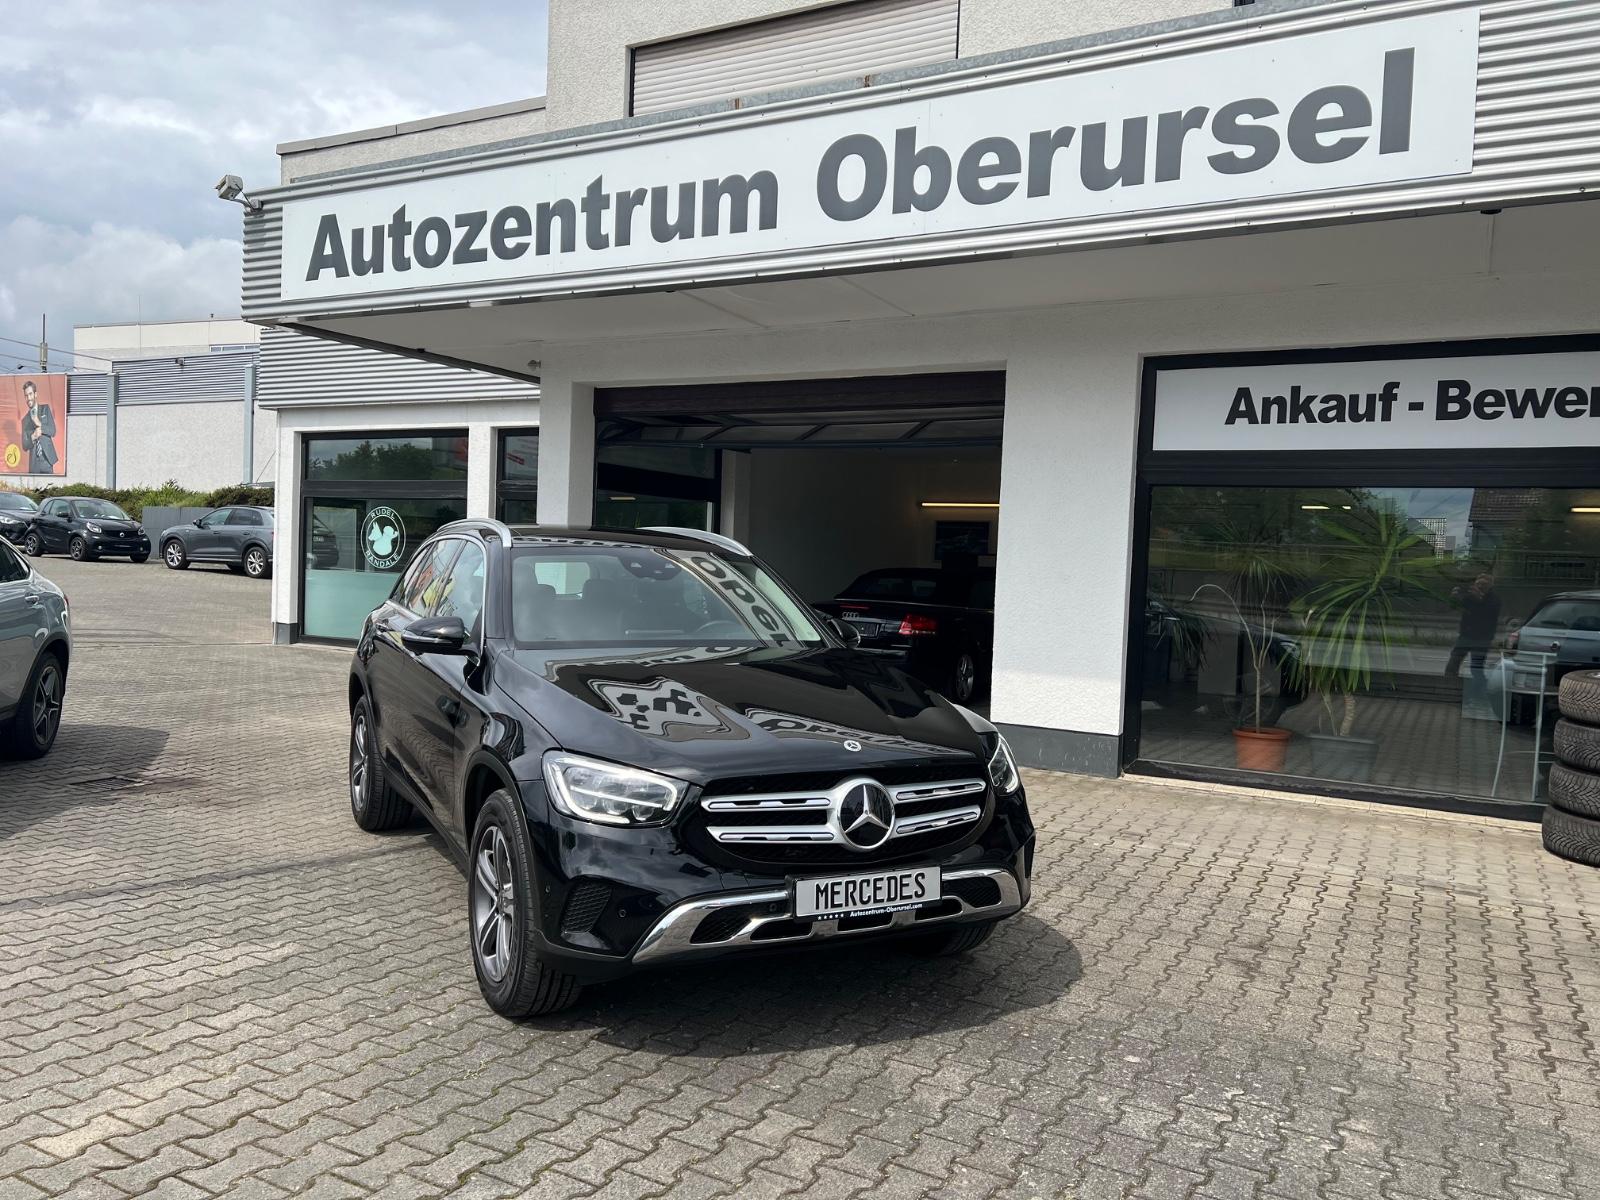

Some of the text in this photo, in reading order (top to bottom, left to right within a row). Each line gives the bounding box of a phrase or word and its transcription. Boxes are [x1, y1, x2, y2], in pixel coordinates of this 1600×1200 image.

[306, 47, 1415, 282] Autozentrum Oberursel
[1224, 381, 1401, 426] Ankauf
[370, 508, 396, 520] RUDEL
[365, 549, 400, 568] RANDALE
[815, 872, 926, 910] MERCEDES
